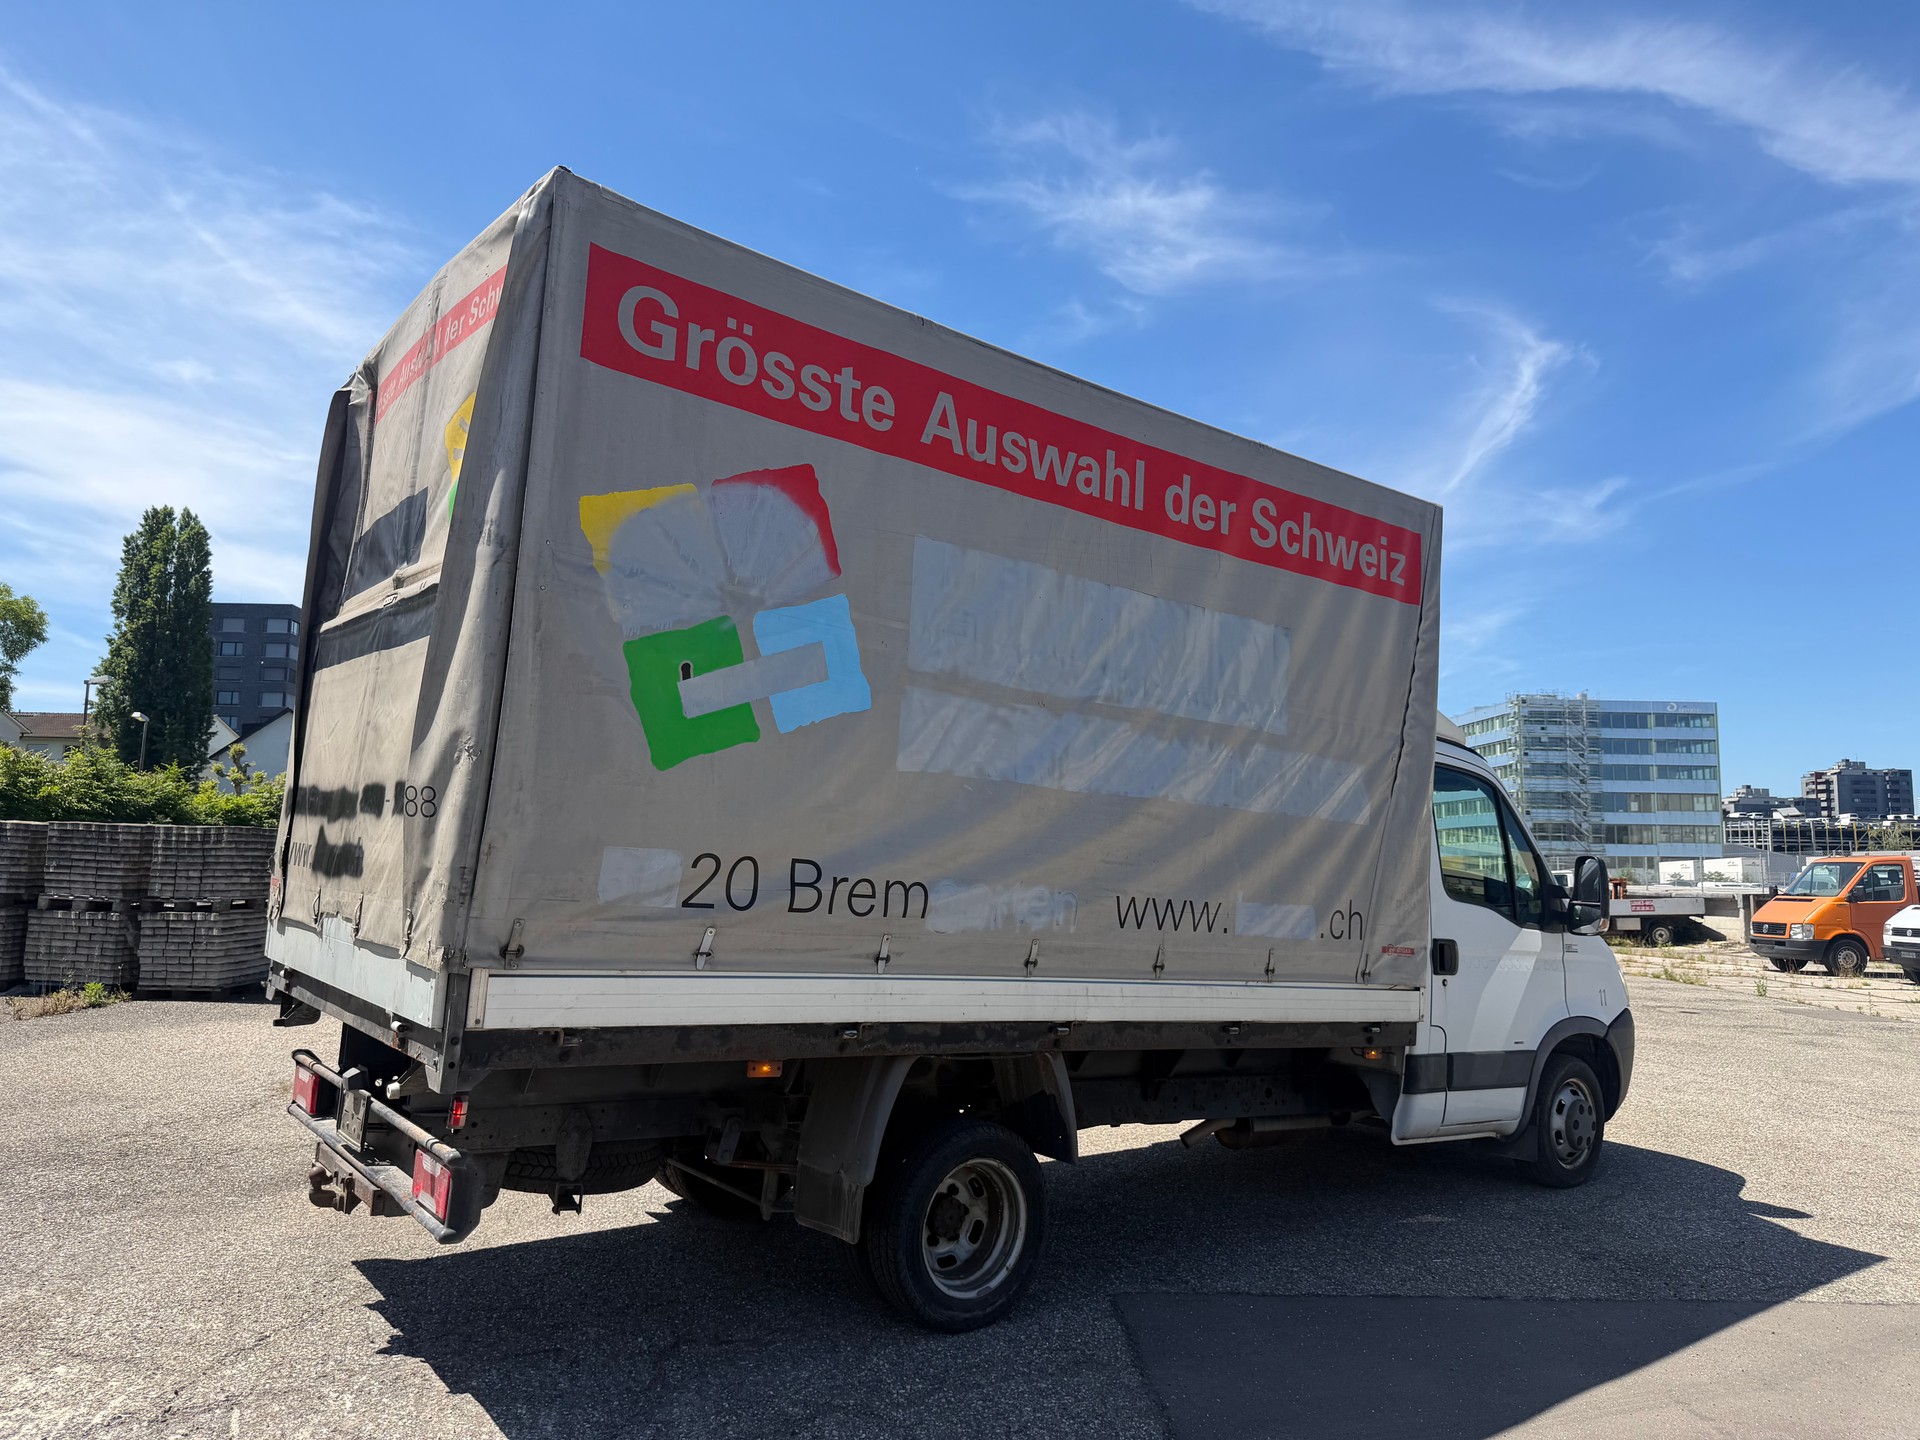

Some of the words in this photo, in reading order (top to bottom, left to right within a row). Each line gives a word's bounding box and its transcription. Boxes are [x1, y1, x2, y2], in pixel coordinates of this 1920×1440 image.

[444, 314, 465, 348] der
[617, 284, 896, 432] Grösste
[920, 390, 1146, 511] Auswahl
[1164, 473, 1237, 535] der
[1249, 498, 1407, 587] Schweiz
[404, 785, 438, 819] 88
[680, 852, 760, 912] 20
[787, 857, 930, 920] Brem
[1115, 895, 1228, 934] www.
[1319, 898, 1364, 941] .ch
